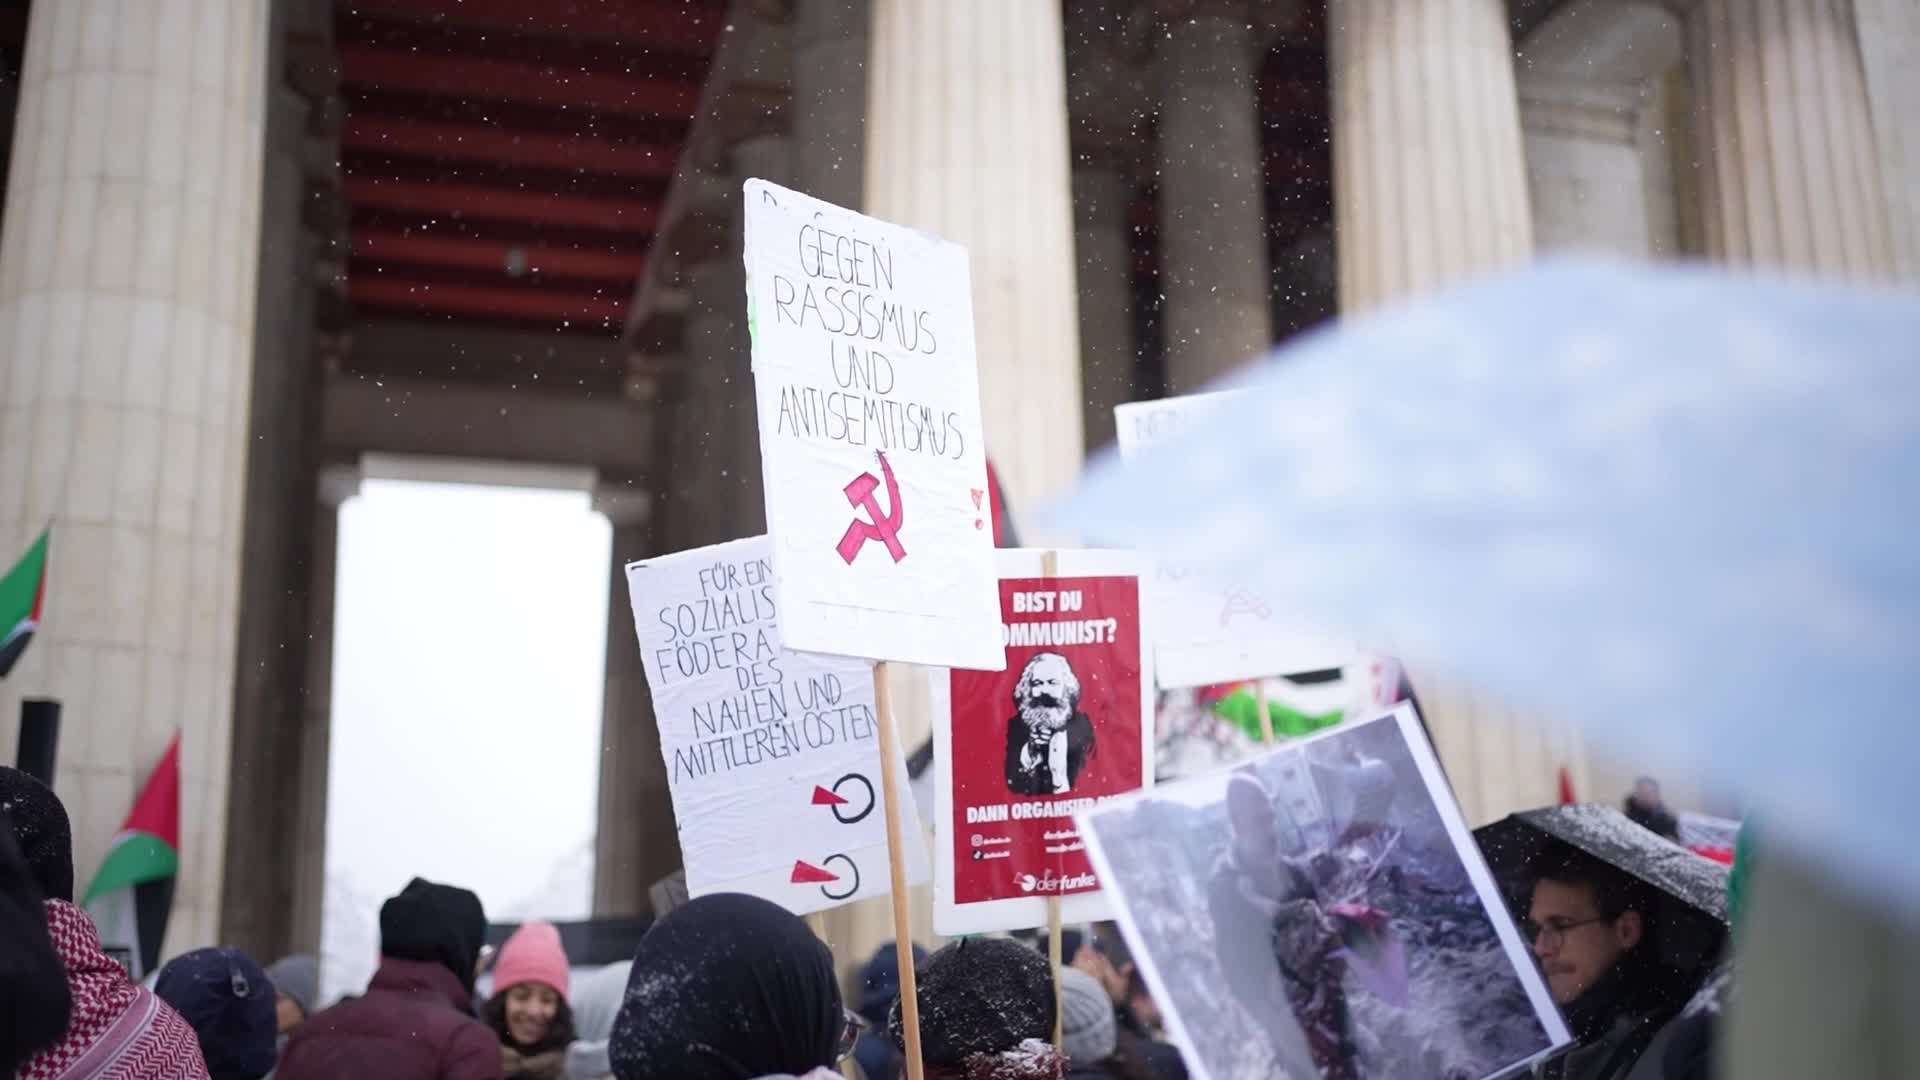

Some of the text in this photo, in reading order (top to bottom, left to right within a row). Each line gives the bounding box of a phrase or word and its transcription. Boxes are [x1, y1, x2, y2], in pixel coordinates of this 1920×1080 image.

[799, 224, 893, 291] GEGEN
[774, 275, 937, 355] RASSISMUS
[831, 338, 894, 395] UND
[778, 384, 964, 460] ANTISEMITISMUS
[699, 562, 742, 597] FÜR
[1012, 590, 1083, 613] BIST DU
[658, 585, 777, 643] SOZIALIS
[1000, 617, 1118, 648] OMMUNIST?
[656, 624, 777, 685] FÖDERA
[736, 657, 784, 692] DES
[692, 673, 842, 739] NAHEN UND
[674, 704, 880, 785] MITTLEREN OSTEN
[966, 803, 1009, 824] DANN
